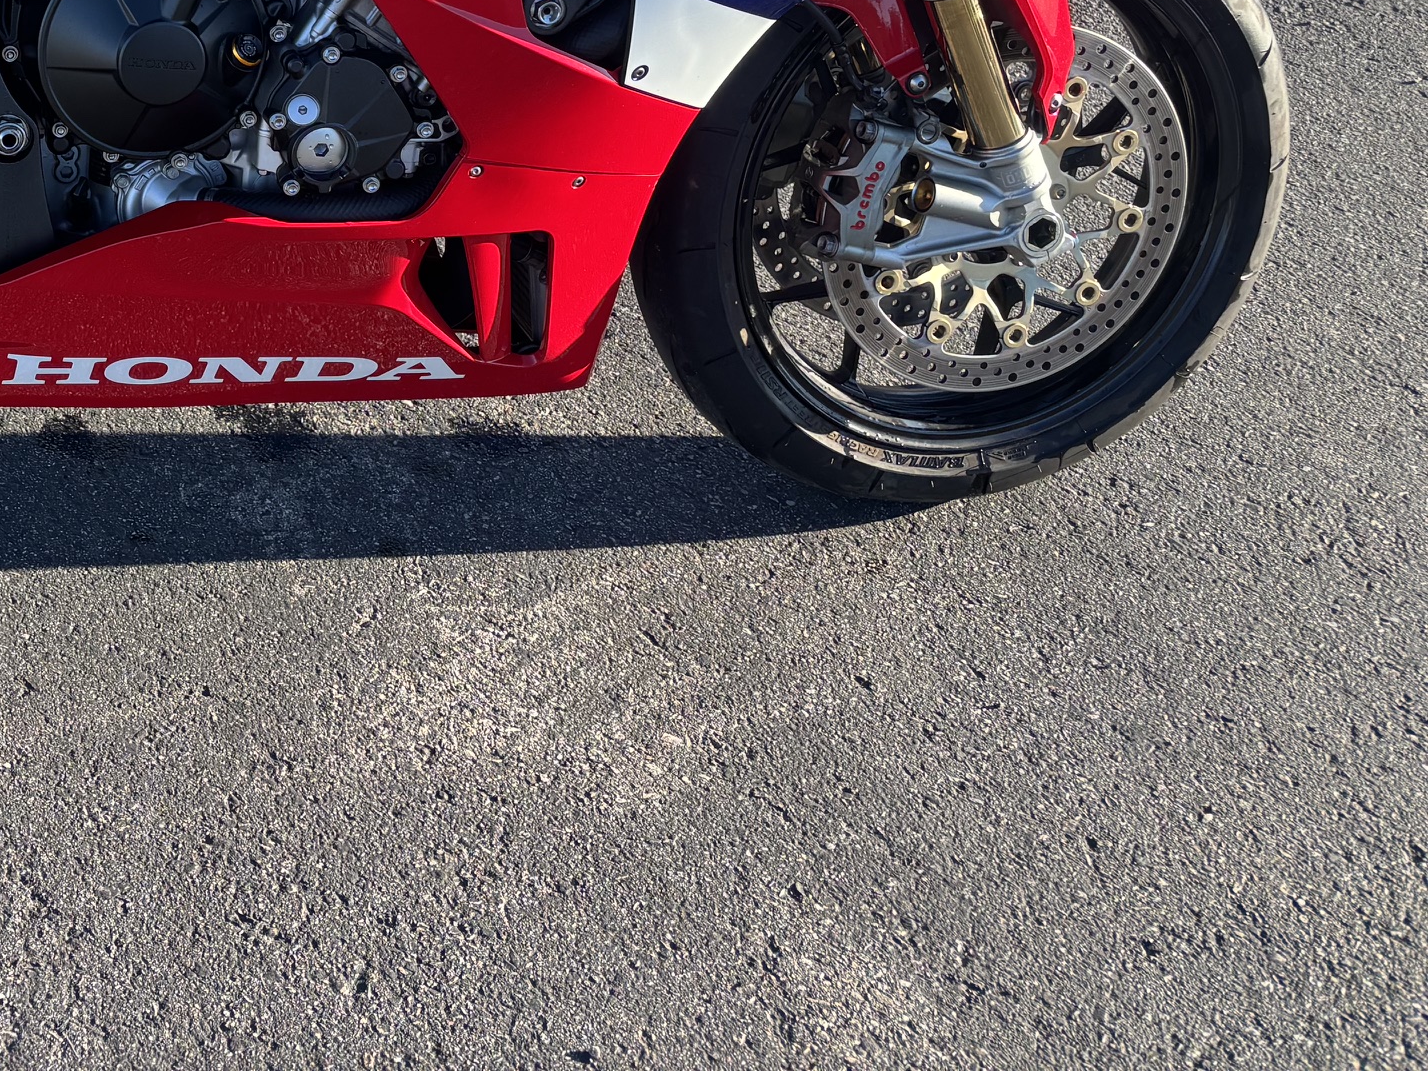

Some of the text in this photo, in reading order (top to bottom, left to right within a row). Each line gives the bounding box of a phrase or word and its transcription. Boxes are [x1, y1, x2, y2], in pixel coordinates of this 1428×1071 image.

[128, 57, 197, 70] HONDA
[850, 161, 886, 230] brembo
[1, 353, 465, 385] HONDA
[879, 450, 965, 469] BATTLAX
